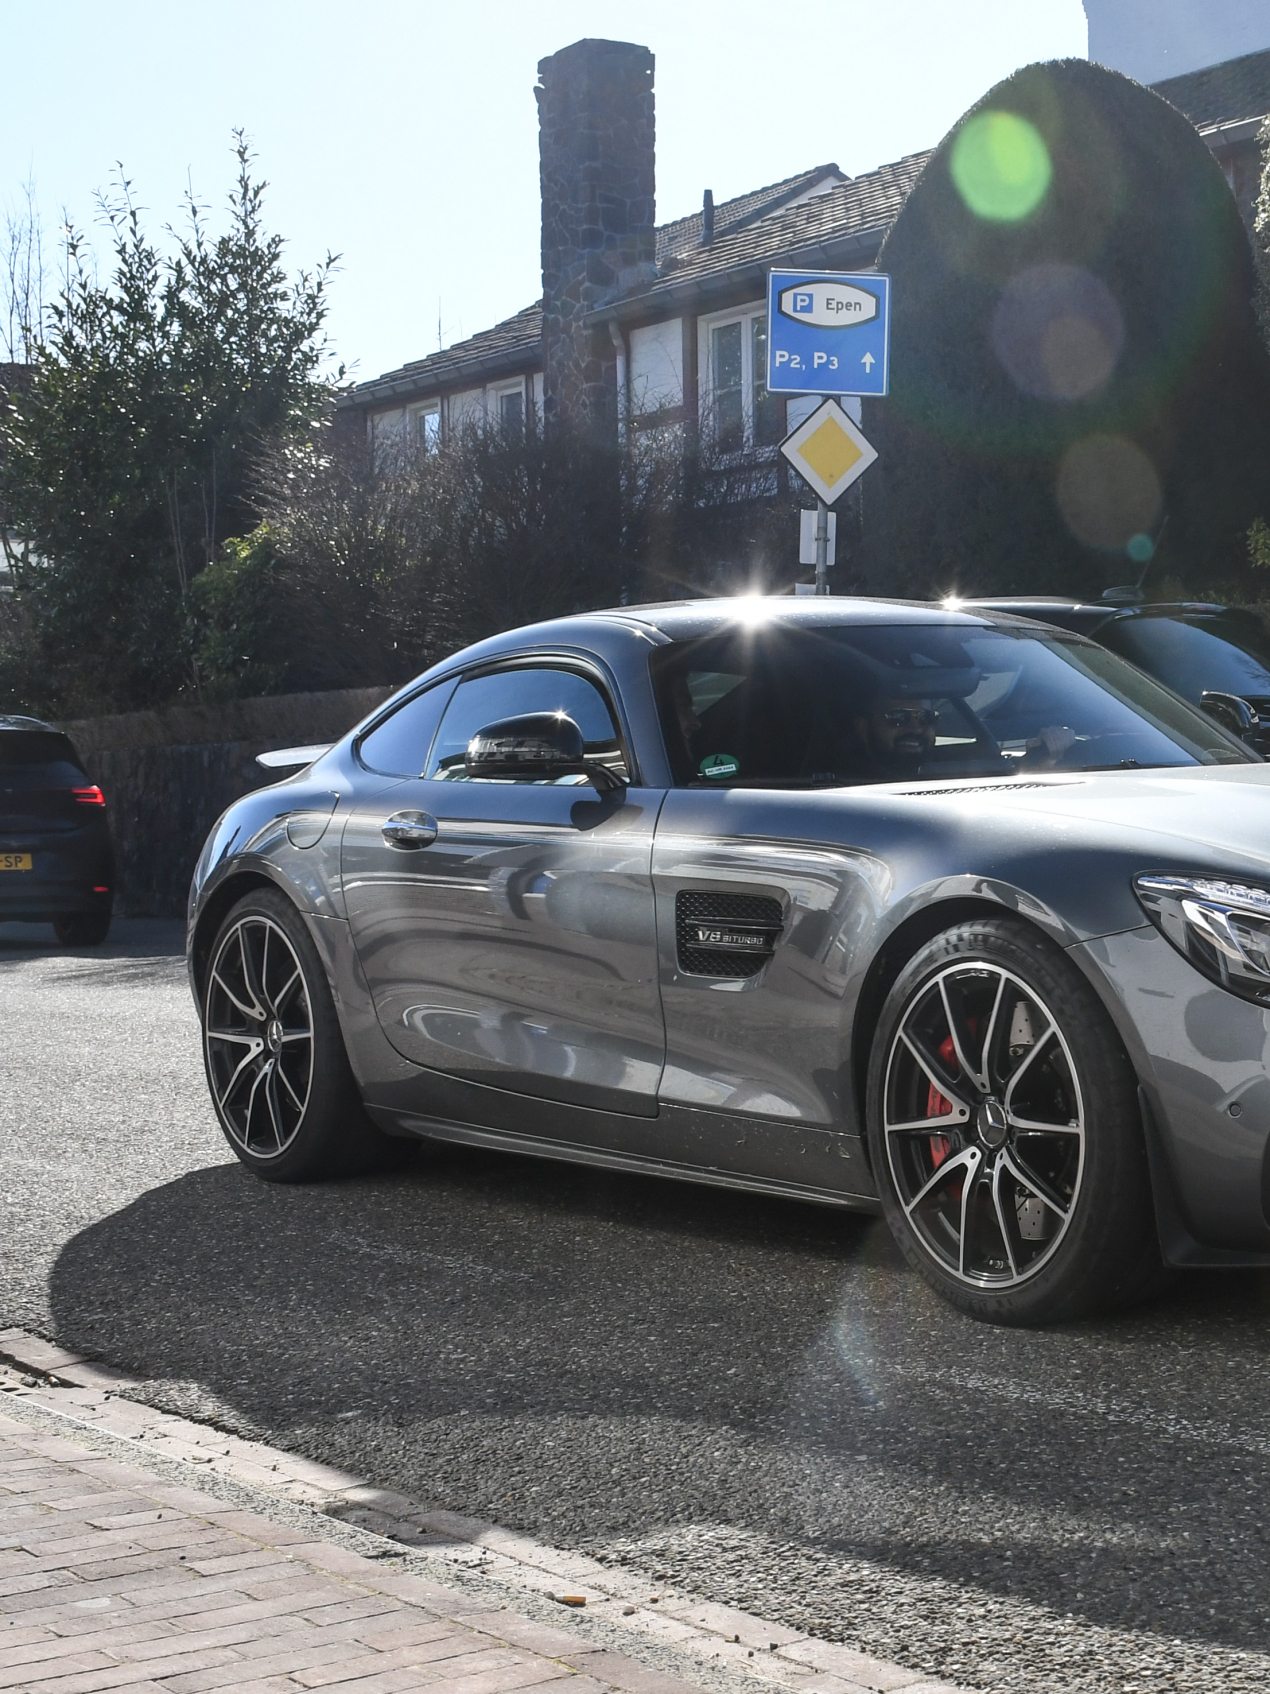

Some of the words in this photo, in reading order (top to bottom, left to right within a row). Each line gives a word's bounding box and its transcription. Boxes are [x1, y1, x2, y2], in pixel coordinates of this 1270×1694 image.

[796, 295, 809, 311] P
[826, 298, 862, 314] Epen
[775, 350, 806, 371] P2,
[813, 352, 839, 370] P3
[697, 930, 721, 942] V8
[722, 935, 764, 945] BITURBO
